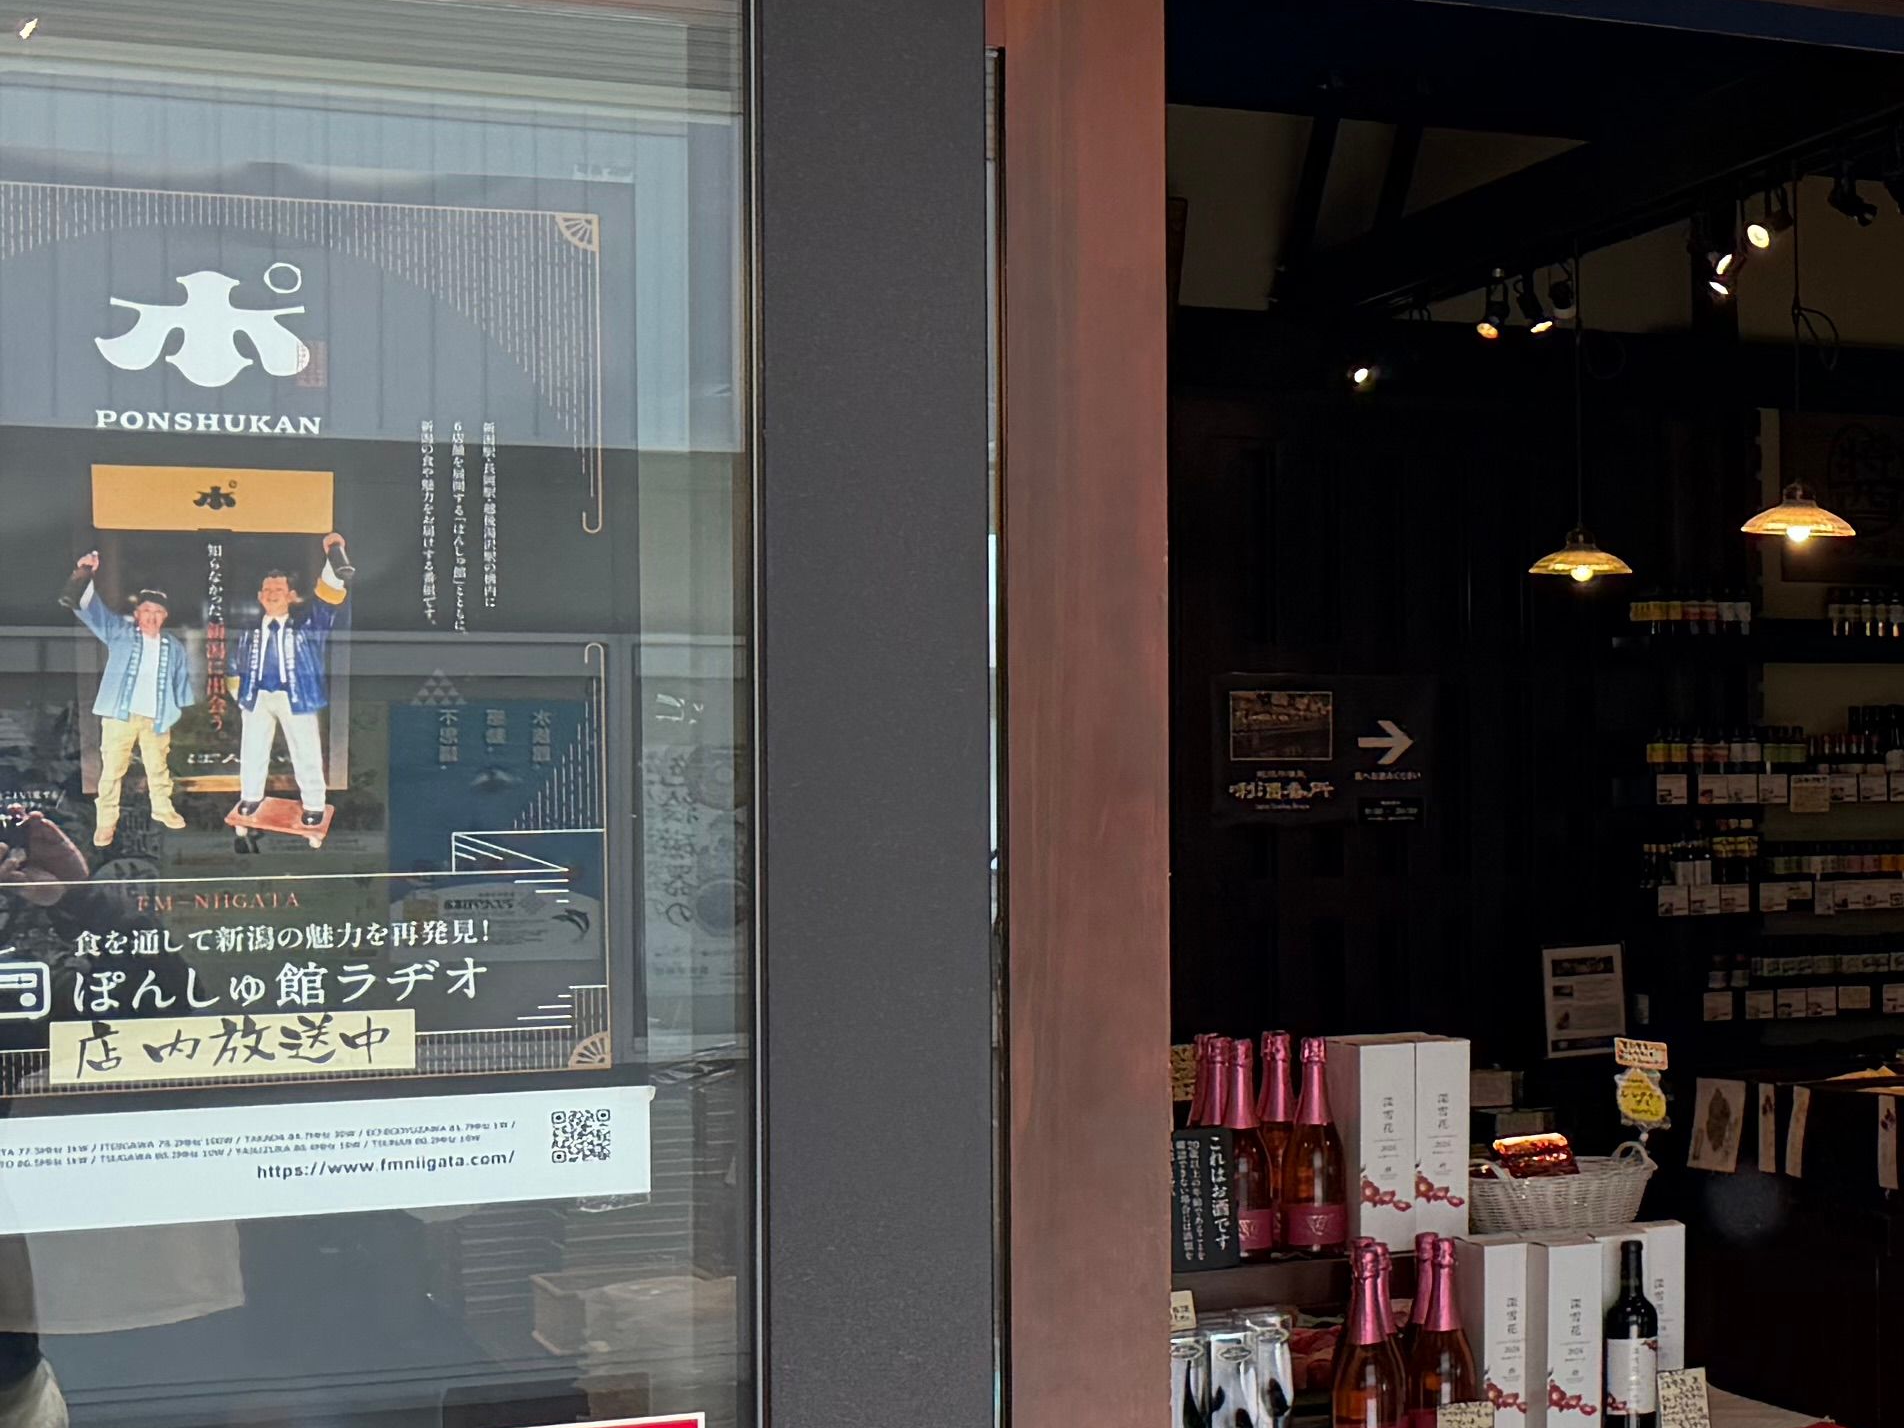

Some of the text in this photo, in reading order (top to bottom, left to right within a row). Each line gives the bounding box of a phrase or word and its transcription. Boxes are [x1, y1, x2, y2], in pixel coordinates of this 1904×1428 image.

[95, 409, 322, 436] PONSHUKAN
[72, 958, 489, 1015] ぽんしゅ館ラヂオ
[77, 1015, 392, 1079] 店内放送中
[257, 1150, 516, 1180] https://www.fmniigata.com/
[1208, 1135, 1231, 1251] これはお酒です
